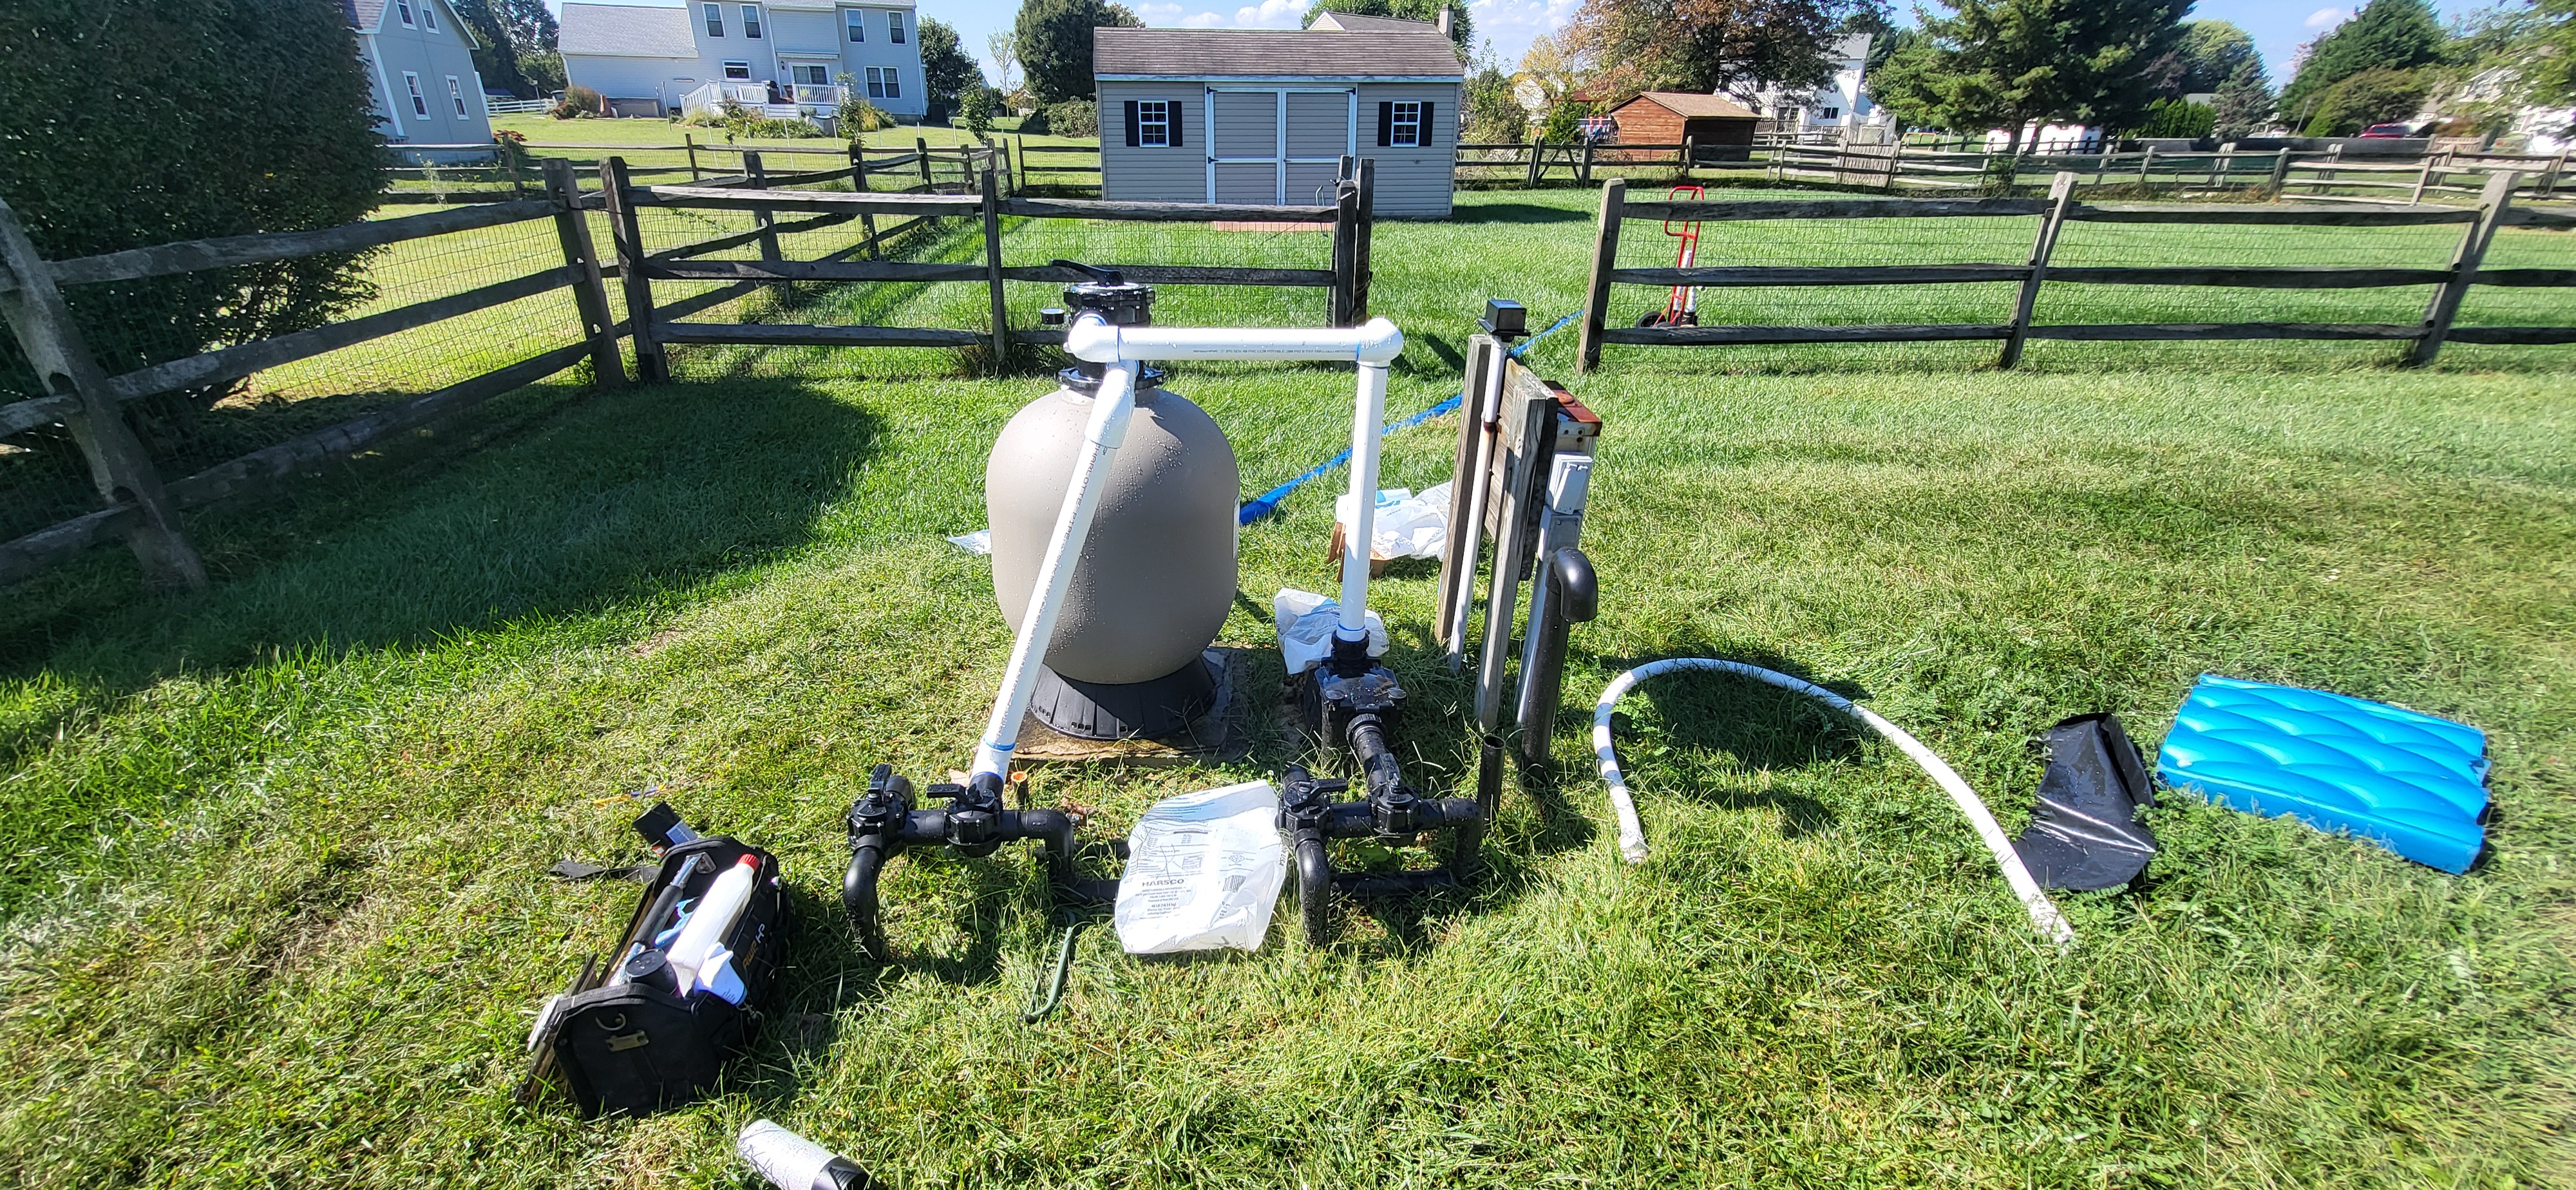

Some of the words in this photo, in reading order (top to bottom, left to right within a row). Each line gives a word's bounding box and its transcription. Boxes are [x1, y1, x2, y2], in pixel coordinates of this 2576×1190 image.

[1076, 443, 1101, 507] CHARLOTTE
[1064, 511, 1077, 540] PIPE
[1142, 878, 1184, 887] HARSCO
[755, 923, 765, 944] HP
